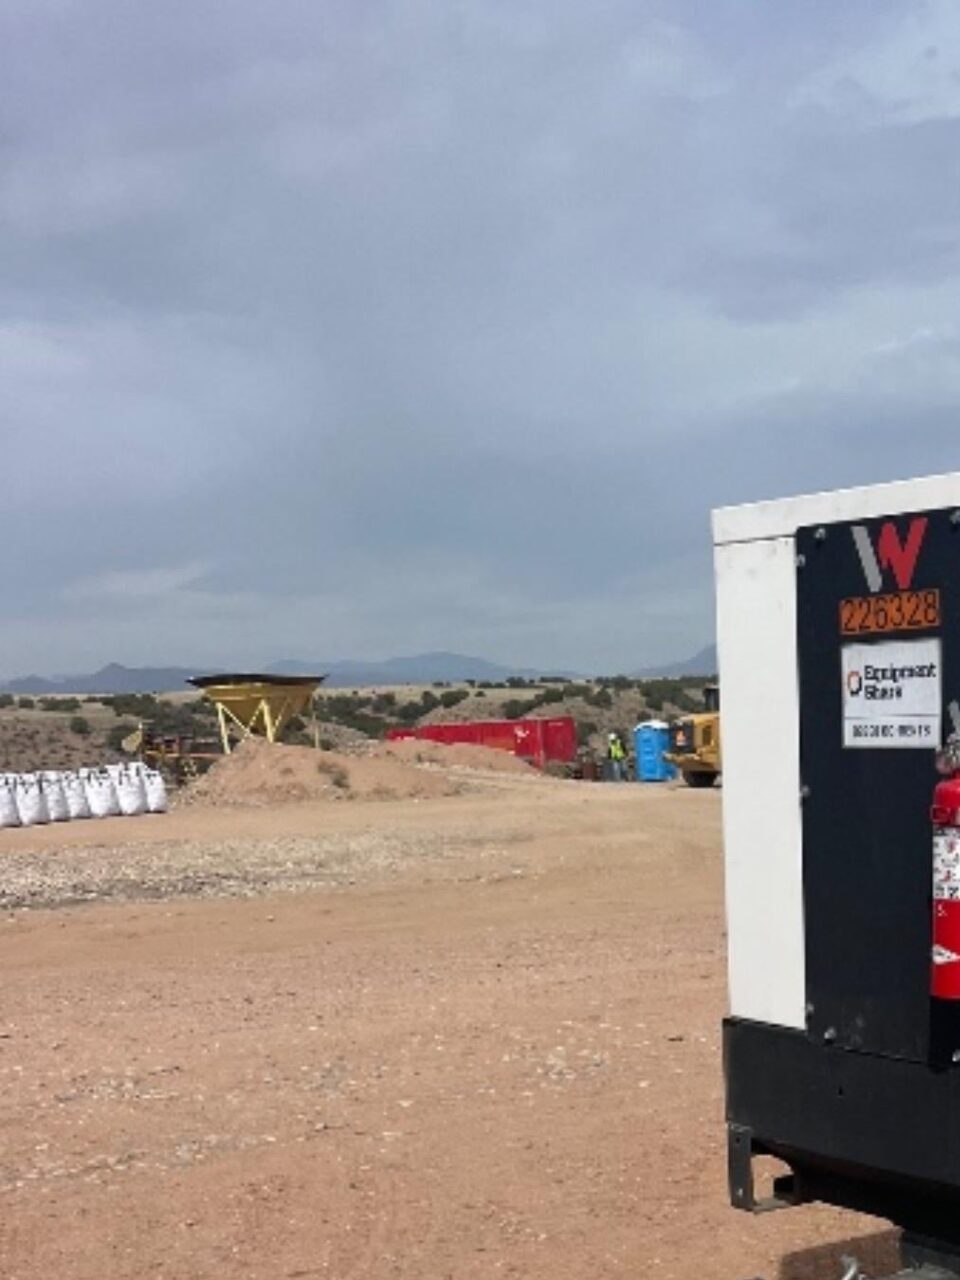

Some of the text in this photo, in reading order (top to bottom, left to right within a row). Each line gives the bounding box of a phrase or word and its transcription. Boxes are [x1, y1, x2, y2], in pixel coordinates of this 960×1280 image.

[843, 592, 938, 632] 226328
[863, 662, 937, 683] Equipment
[863, 684, 903, 700] Share
